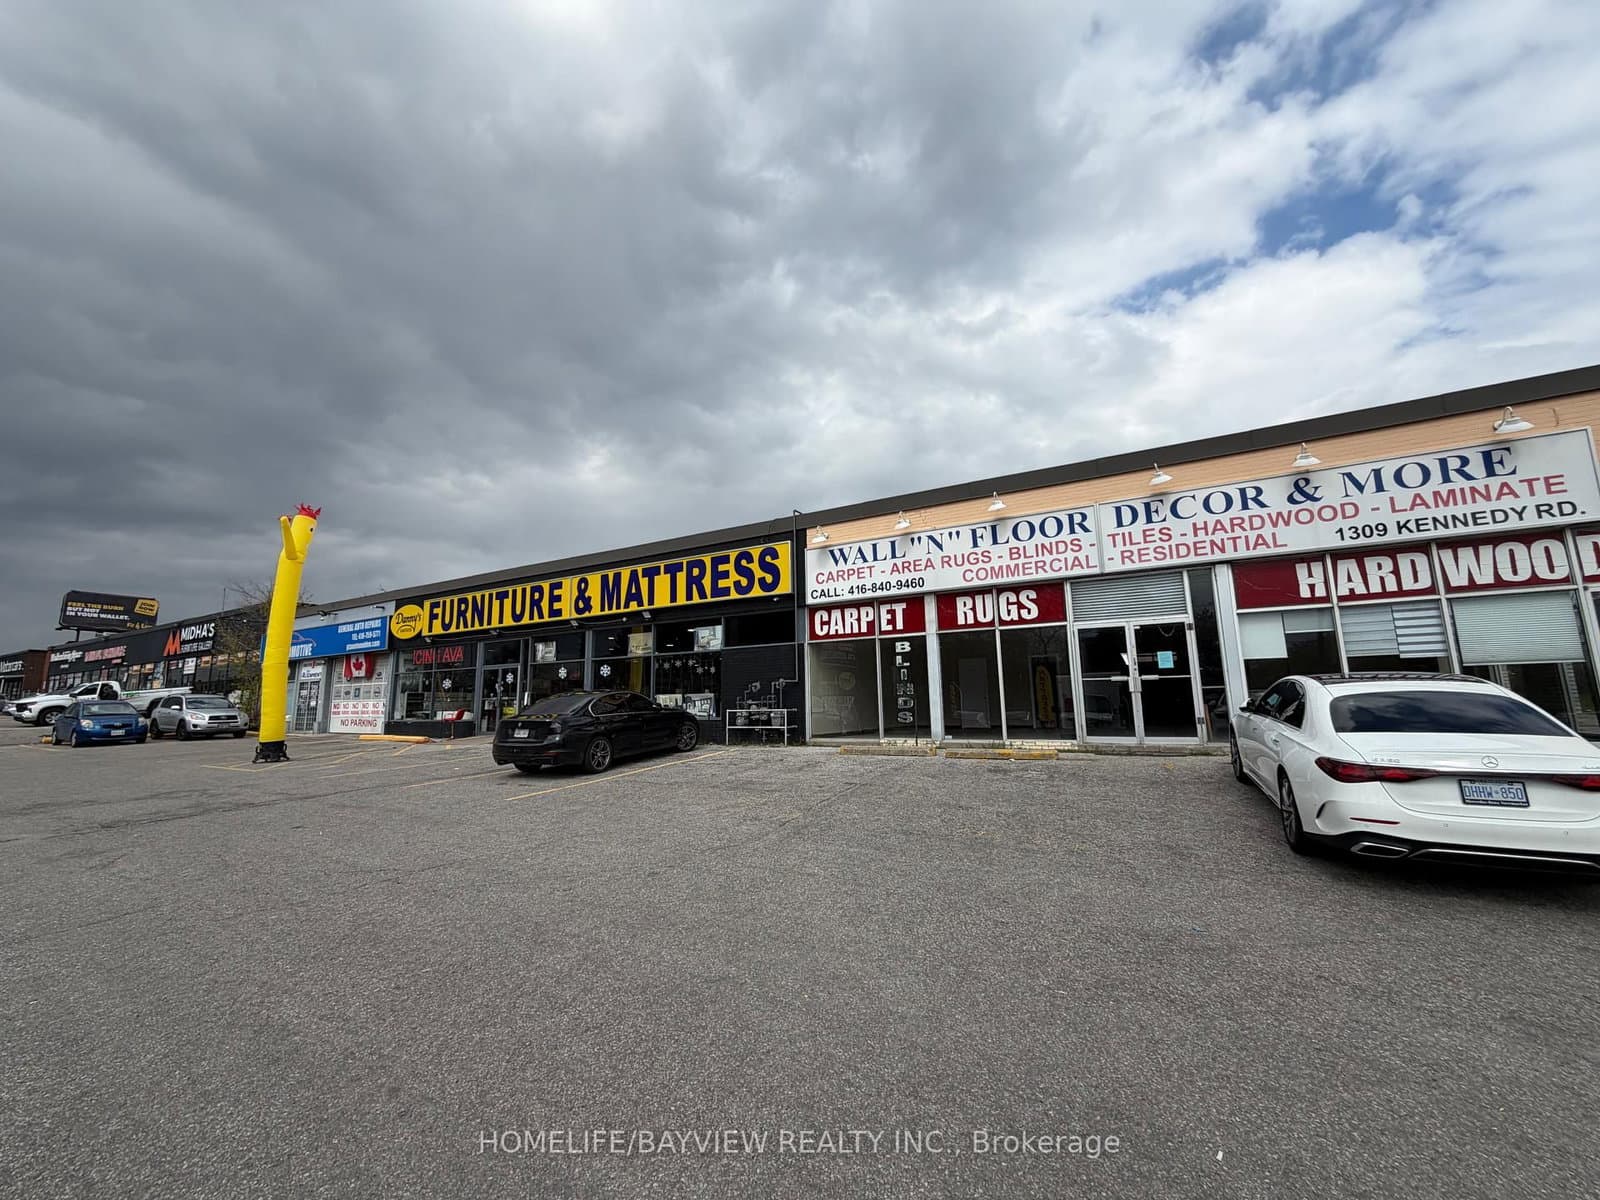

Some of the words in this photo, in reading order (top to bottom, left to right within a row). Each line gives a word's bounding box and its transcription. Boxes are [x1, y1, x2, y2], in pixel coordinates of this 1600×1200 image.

[1112, 484, 1277, 529] DECOR
[1286, 477, 1324, 505] &
[1340, 445, 1518, 499] MORE
[1107, 525, 1173, 549] TILES
[1192, 501, 1360, 538] HARDWOOD
[1389, 474, 1568, 514] LAMINATE
[1334, 522, 1389, 542] 1309
[1396, 505, 1532, 535] KENNEDY
[1535, 499, 1587, 521] RD.
[827, 539, 907, 567] WALL
[969, 511, 1092, 549] FLOOR
[1119, 532, 1288, 565] RESIDENTIAL
[815, 565, 874, 585] CARPET
[890, 558, 936, 576] AREA
[941, 550, 992, 569] RUGS
[1009, 537, 1083, 562] BLINDS
[962, 554, 1098, 584] COMMERCIAL
[1295, 533, 1600, 599] HARDWOOD
[427, 581, 564, 634] FURNITURE
[574, 576, 593, 616] &
[600, 546, 781, 611] MATTRESS
[810, 586, 845, 600] CALL:
[848, 577, 925, 595] 416-840-9460
[956, 589, 1039, 626] RUGS
[181, 622, 215, 641] MIDHA'S
[814, 602, 907, 636] CARPET
[340, 719, 349, 727] NO
[350, 719, 377, 728] PARKING
